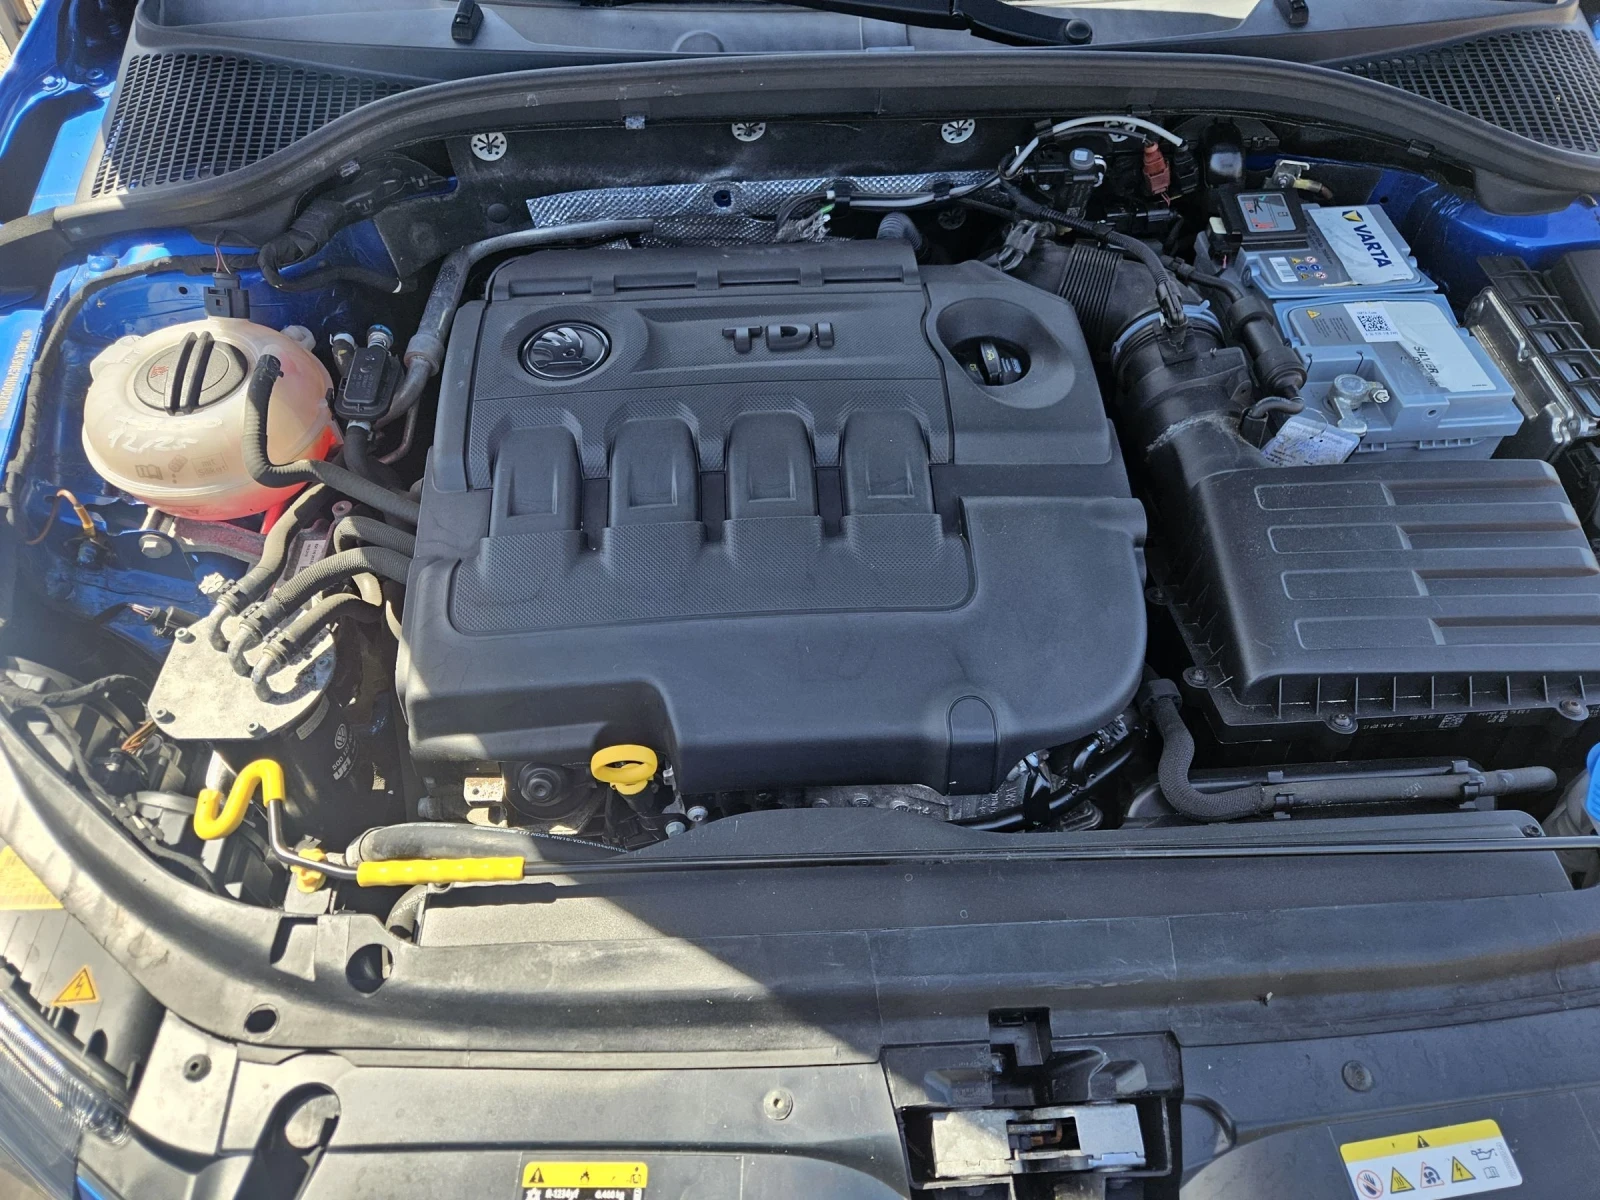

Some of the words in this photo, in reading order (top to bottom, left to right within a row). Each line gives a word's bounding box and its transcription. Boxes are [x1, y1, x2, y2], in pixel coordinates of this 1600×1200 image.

[1353, 224, 1393, 269] VARTA
[721, 322, 835, 354] TDI
[1412, 345, 1440, 376] SILVER
